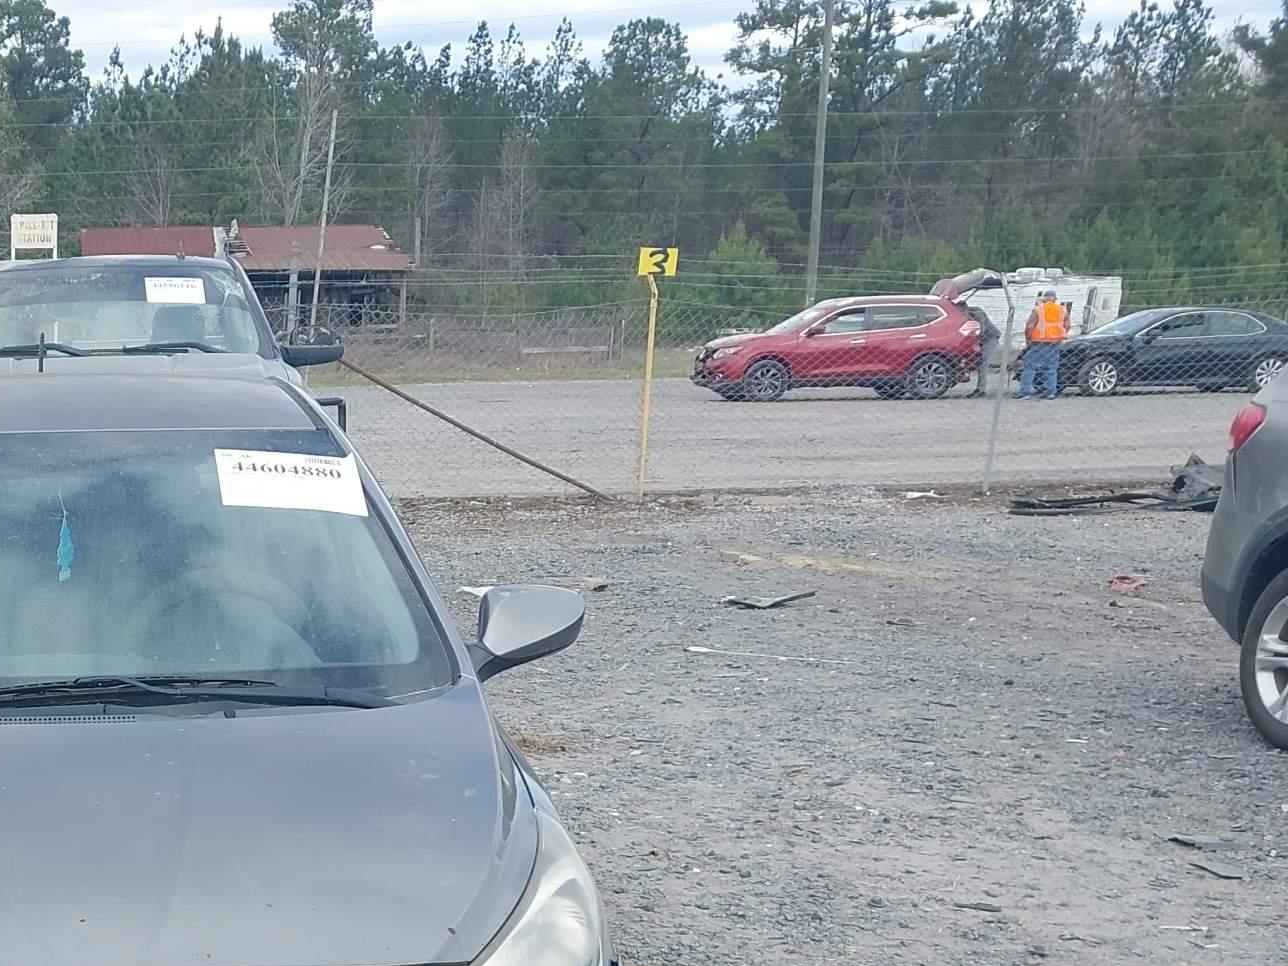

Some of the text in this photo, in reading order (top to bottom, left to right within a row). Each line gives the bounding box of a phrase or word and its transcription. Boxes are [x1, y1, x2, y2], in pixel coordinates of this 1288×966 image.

[15, 220, 54, 230] PILL-T
[17, 232, 52, 243] TATION
[648, 249, 669, 274] 3
[231, 461, 342, 479] 44604880
